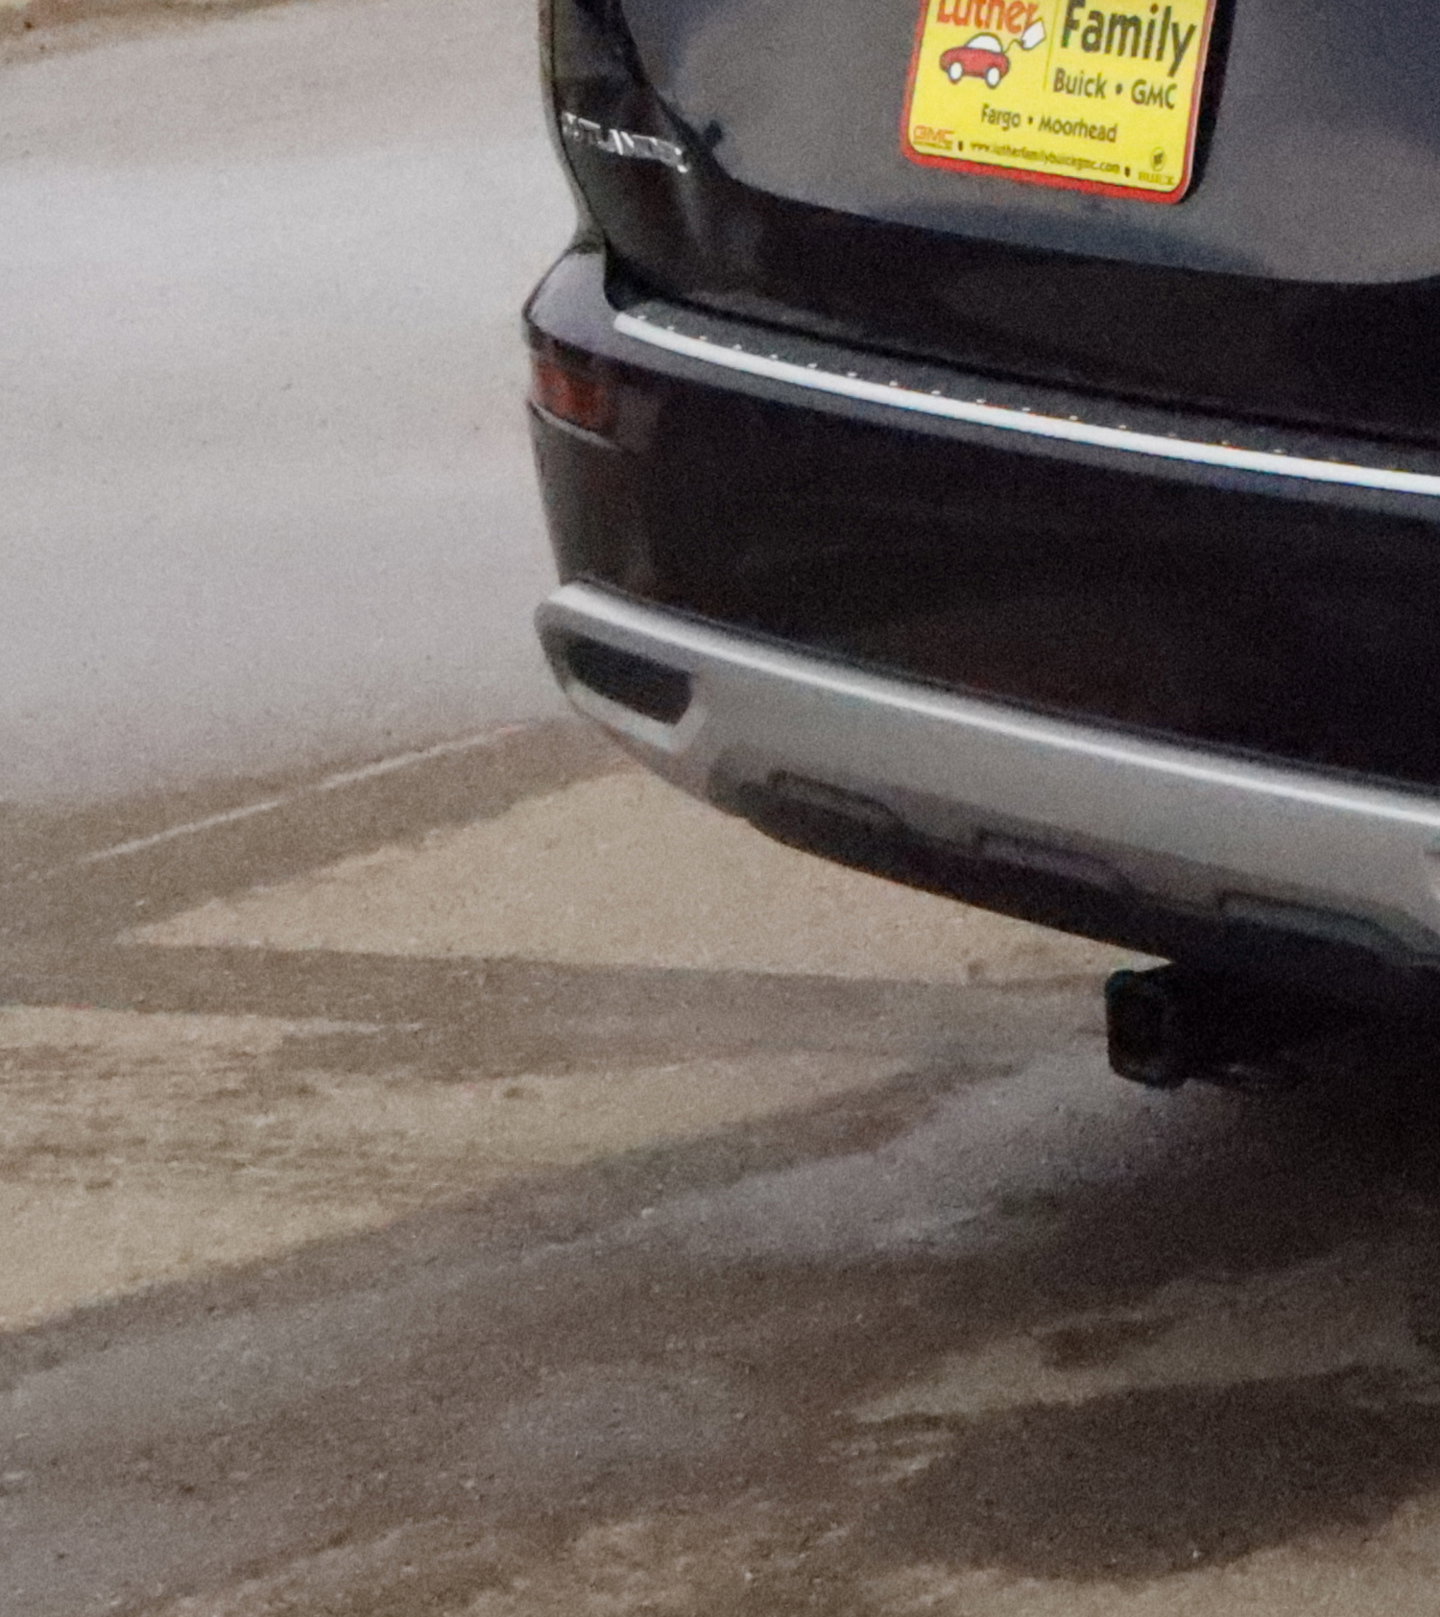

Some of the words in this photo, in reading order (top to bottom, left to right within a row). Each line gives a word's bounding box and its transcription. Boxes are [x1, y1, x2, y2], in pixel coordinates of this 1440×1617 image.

[1053, 68, 1106, 100] Buick
[1131, 79, 1178, 110] GMC
[913, 125, 955, 142] GMC
[981, 103, 1021, 131] Fargo
[1038, 116, 1118, 143] Moorhead
